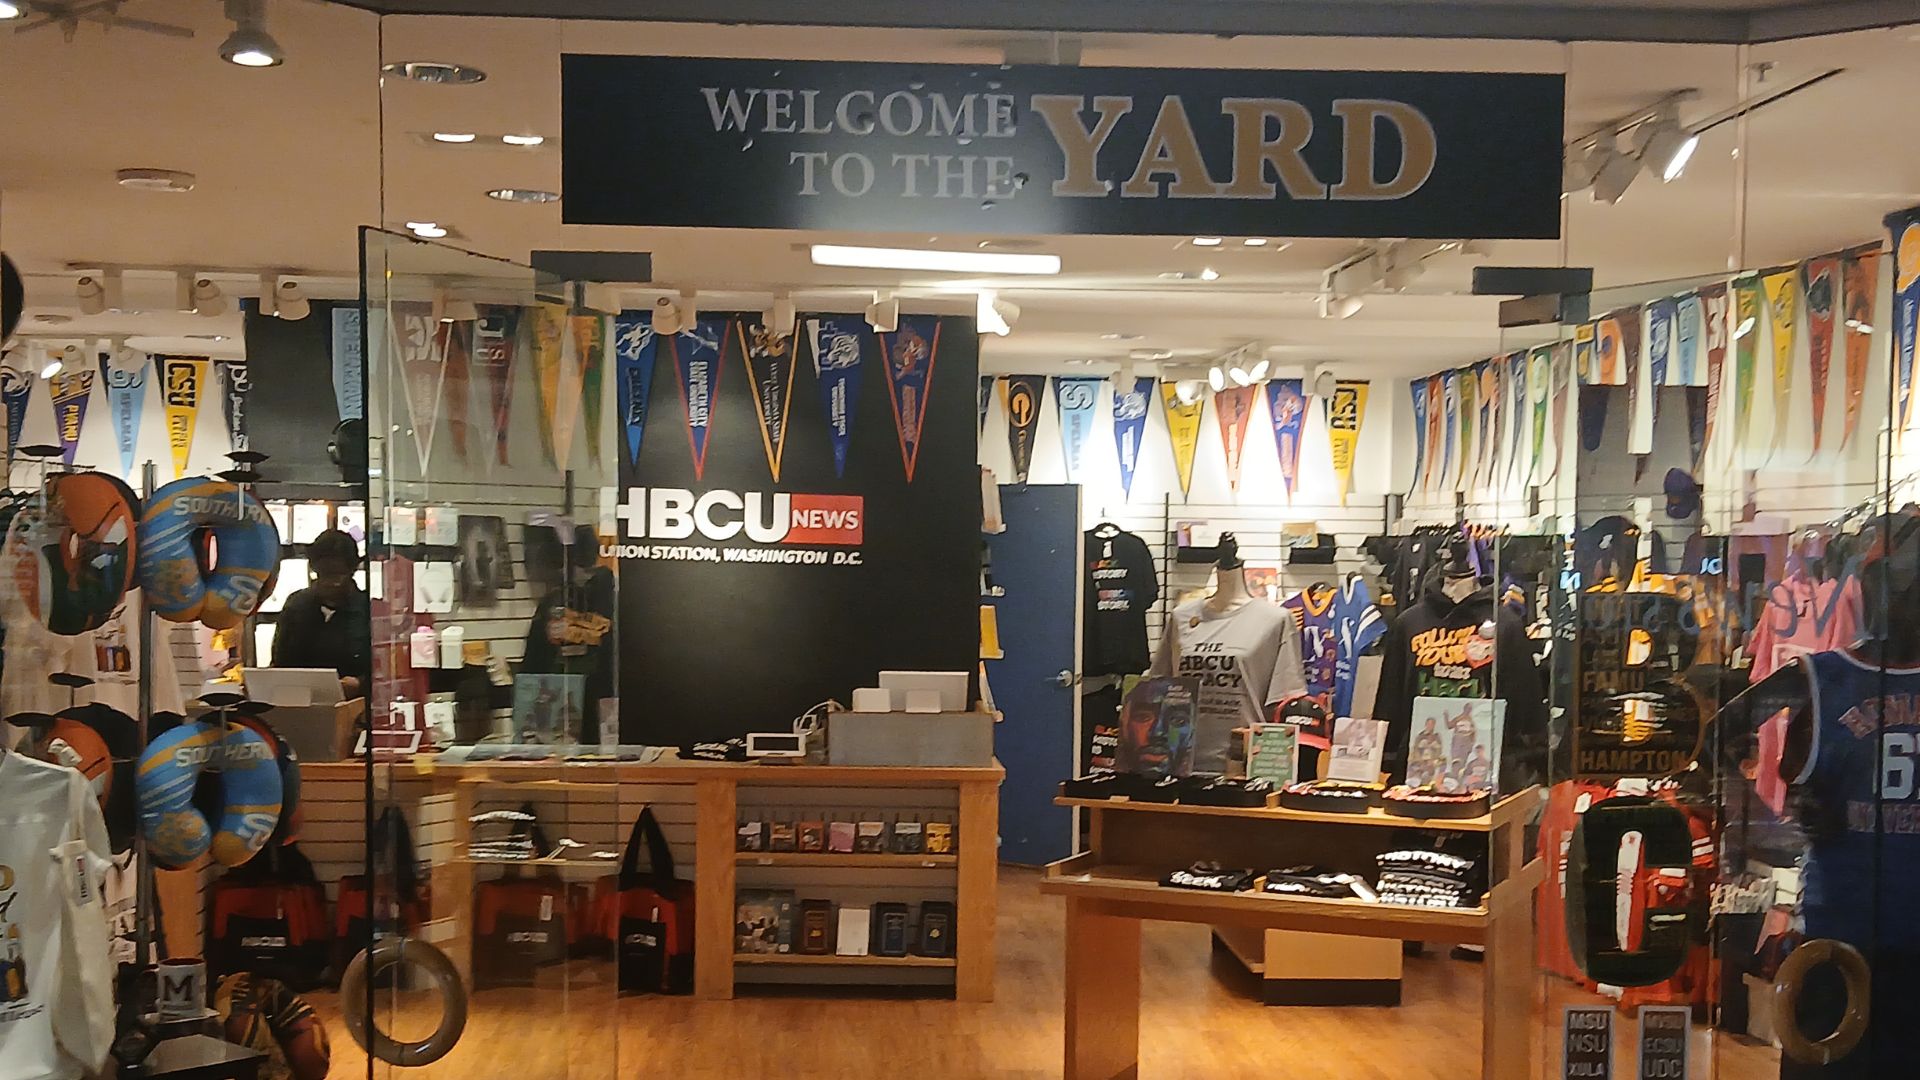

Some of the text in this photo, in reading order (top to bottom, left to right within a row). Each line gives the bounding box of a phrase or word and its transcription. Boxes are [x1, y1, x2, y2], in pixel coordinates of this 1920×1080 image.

[701, 87, 1017, 138] WELCOME
[1030, 94, 1438, 201] YARD
[789, 151, 1017, 199] TO THE
[600, 486, 860, 544] HBCU NEWS
[651, 545, 722, 565] STATION,
[723, 548, 828, 565] WASHINGTON
[832, 551, 864, 566] D.C.
[1194, 641, 1224, 653] THE
[1179, 654, 1236, 672] HBCU
[163, 975, 194, 1002] M
[1644, 1059, 1682, 1079] UDC
